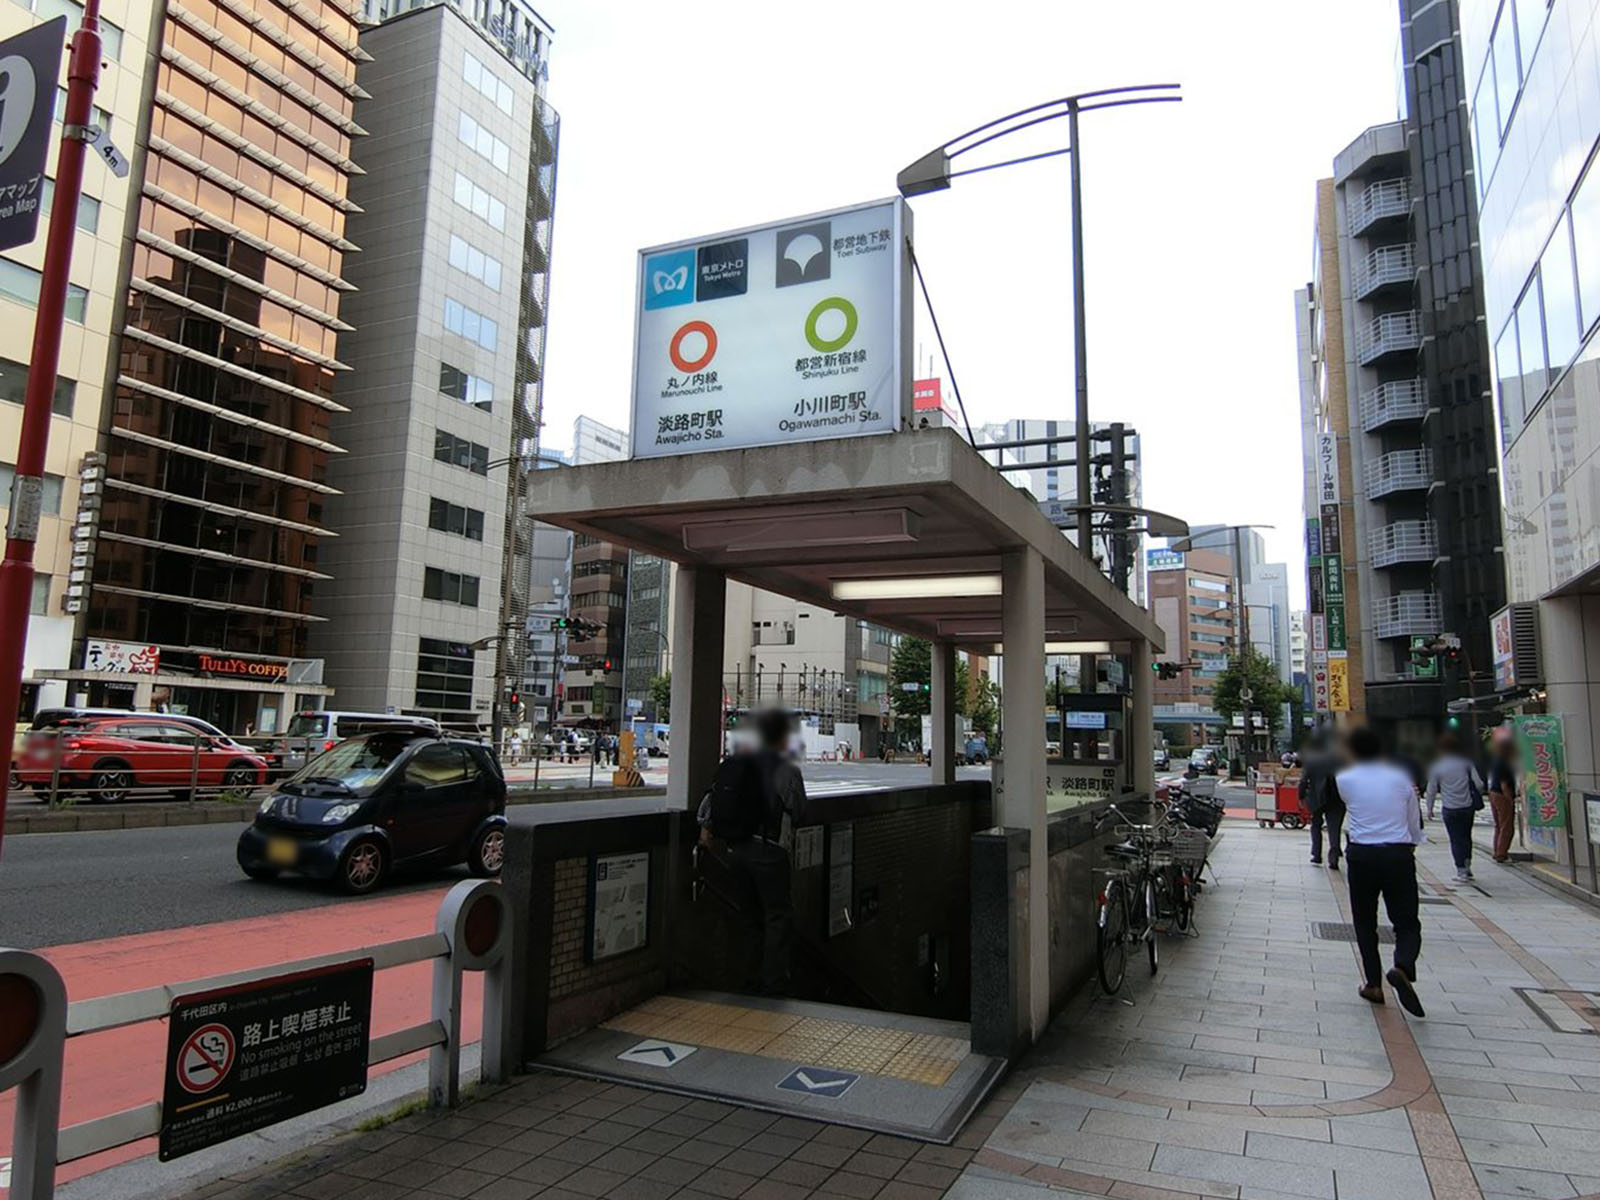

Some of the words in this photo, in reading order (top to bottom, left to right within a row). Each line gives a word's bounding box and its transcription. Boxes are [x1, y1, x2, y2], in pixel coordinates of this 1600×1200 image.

[102, 145, 119, 168] 4m
[15, 197, 37, 213] Map
[833, 229, 891, 251] 都営地下鉄
[837, 247, 854, 258] Toei
[855, 242, 887, 256] Subway
[702, 258, 744, 274] 東京メトロ
[703, 271, 721, 283] Tokyo
[721, 269, 741, 280] Metro
[795, 349, 867, 372] 都営新宿線
[666, 371, 718, 390] 丸ノ内線
[802, 368, 839, 380] Shinjuku
[841, 365, 859, 376] Line
[661, 387, 705, 399] Marunouchi
[707, 383, 723, 393] Line
[793, 391, 867, 417] 小川町駅
[657, 408, 723, 433] 淡路町駅
[779, 412, 856, 432] Ogawamachi
[859, 409, 882, 422] Sta.
[655, 430, 702, 446] Awajicho
[704, 428, 725, 440] Sta.
[199, 654, 248, 674] TULLY'S
[248, 663, 288, 677] COFFE
[1062, 777, 1114, 791] 淡路町駅
[181, 1002, 228, 1022] 千代田区内
[241, 1001, 352, 1049] 路上喫煙禁止
[241, 1050, 257, 1065] No
[258, 1042, 302, 1063] smoking
[304, 1034, 317, 1049] on
[318, 1028, 334, 1045] the
[335, 1022, 363, 1041] street
